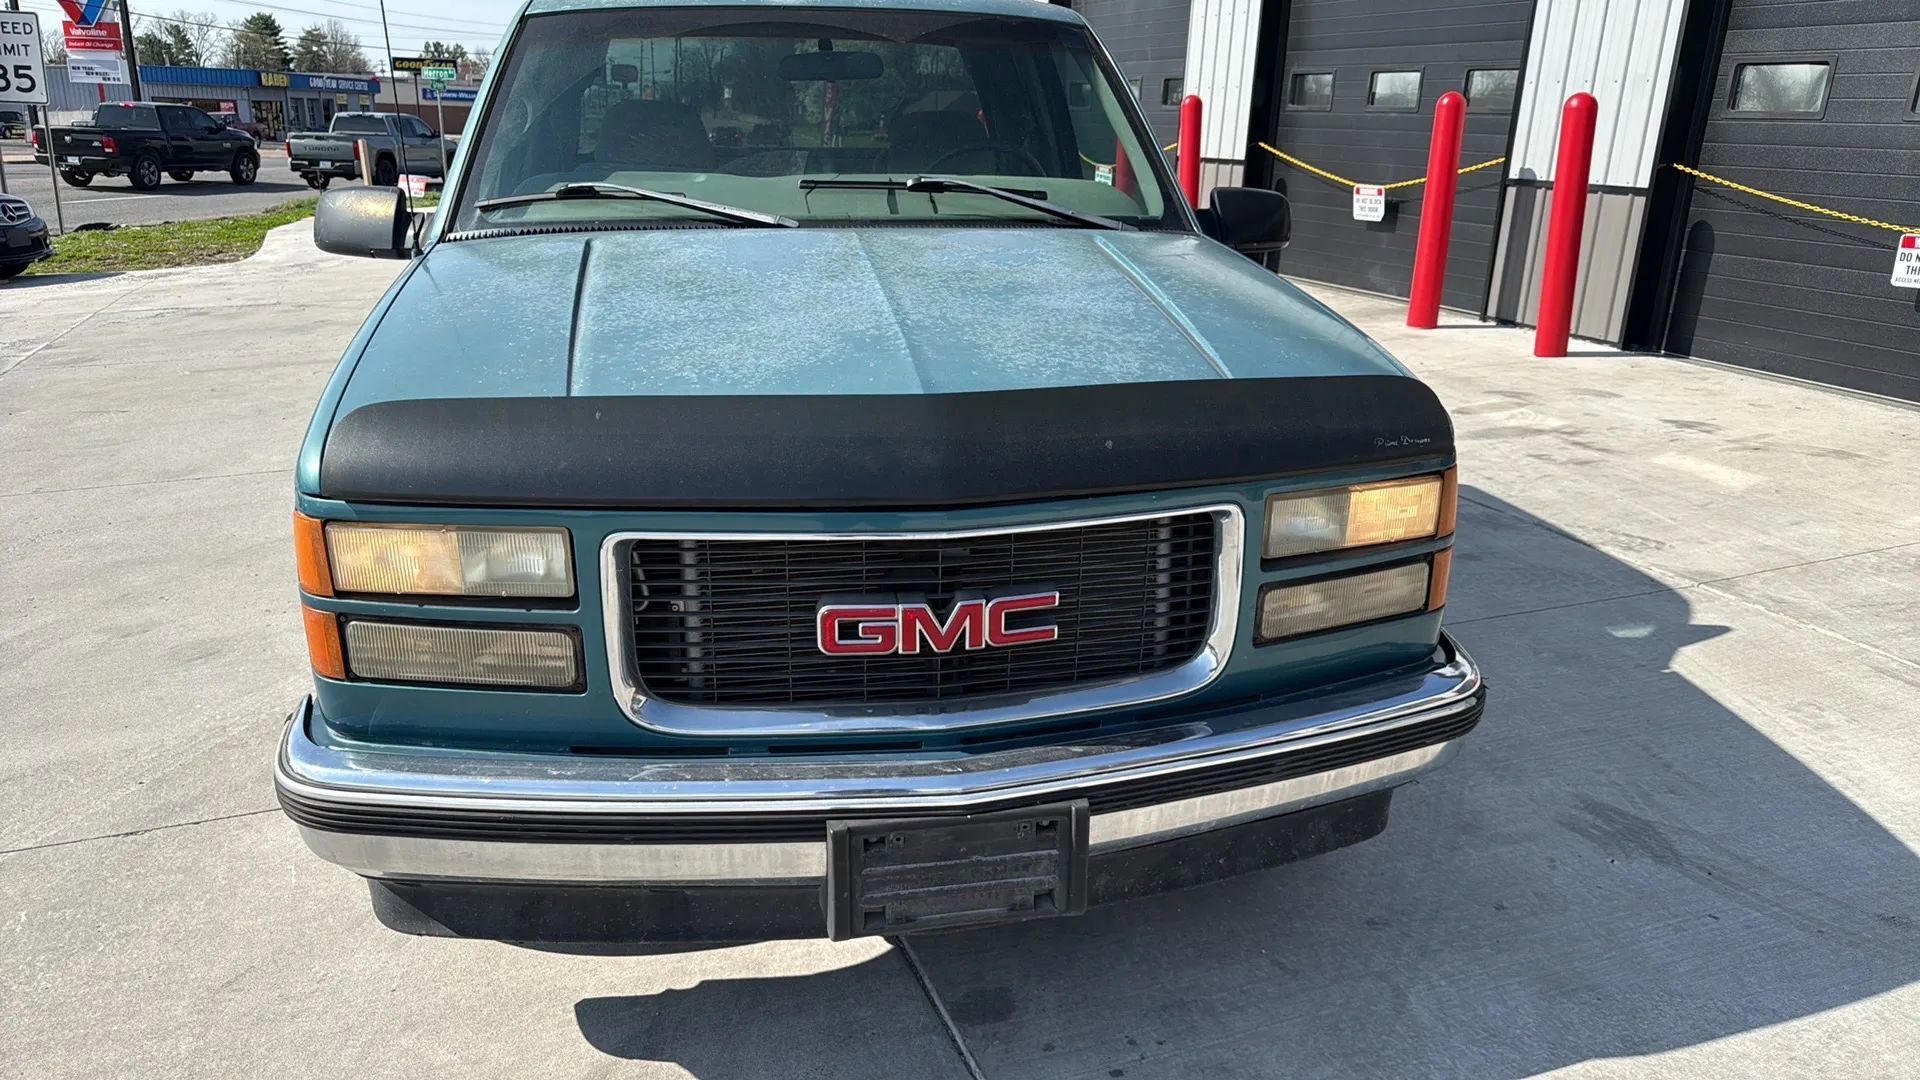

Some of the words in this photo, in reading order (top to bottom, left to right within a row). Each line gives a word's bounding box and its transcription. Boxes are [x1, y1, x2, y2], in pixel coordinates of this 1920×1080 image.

[0, 21, 33, 35] EED
[69, 27, 107, 36] Valvoline
[0, 43, 31, 57] MIT
[1900, 252, 1912, 262] DO
[816, 591, 1060, 656] GMC
